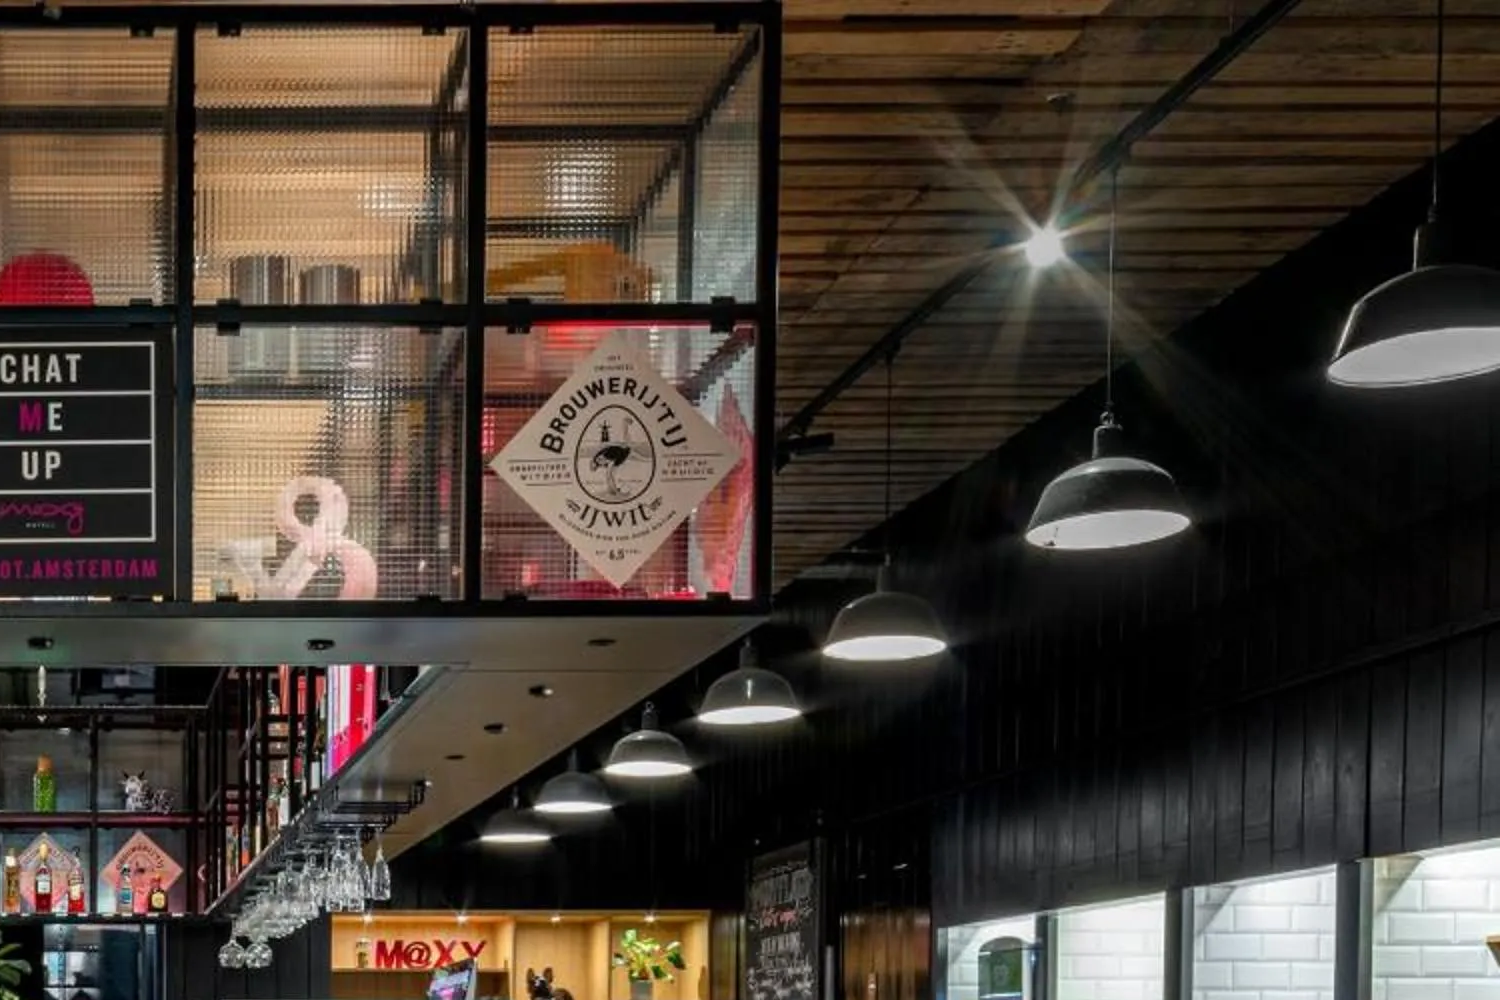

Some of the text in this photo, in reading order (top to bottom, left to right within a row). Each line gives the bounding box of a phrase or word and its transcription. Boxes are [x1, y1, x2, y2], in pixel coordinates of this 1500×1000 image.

[0, 354, 81, 383] CHAT
[19, 402, 63, 431] ME
[21, 451, 61, 480] UP
[375, 940, 488, 969] M@XY
